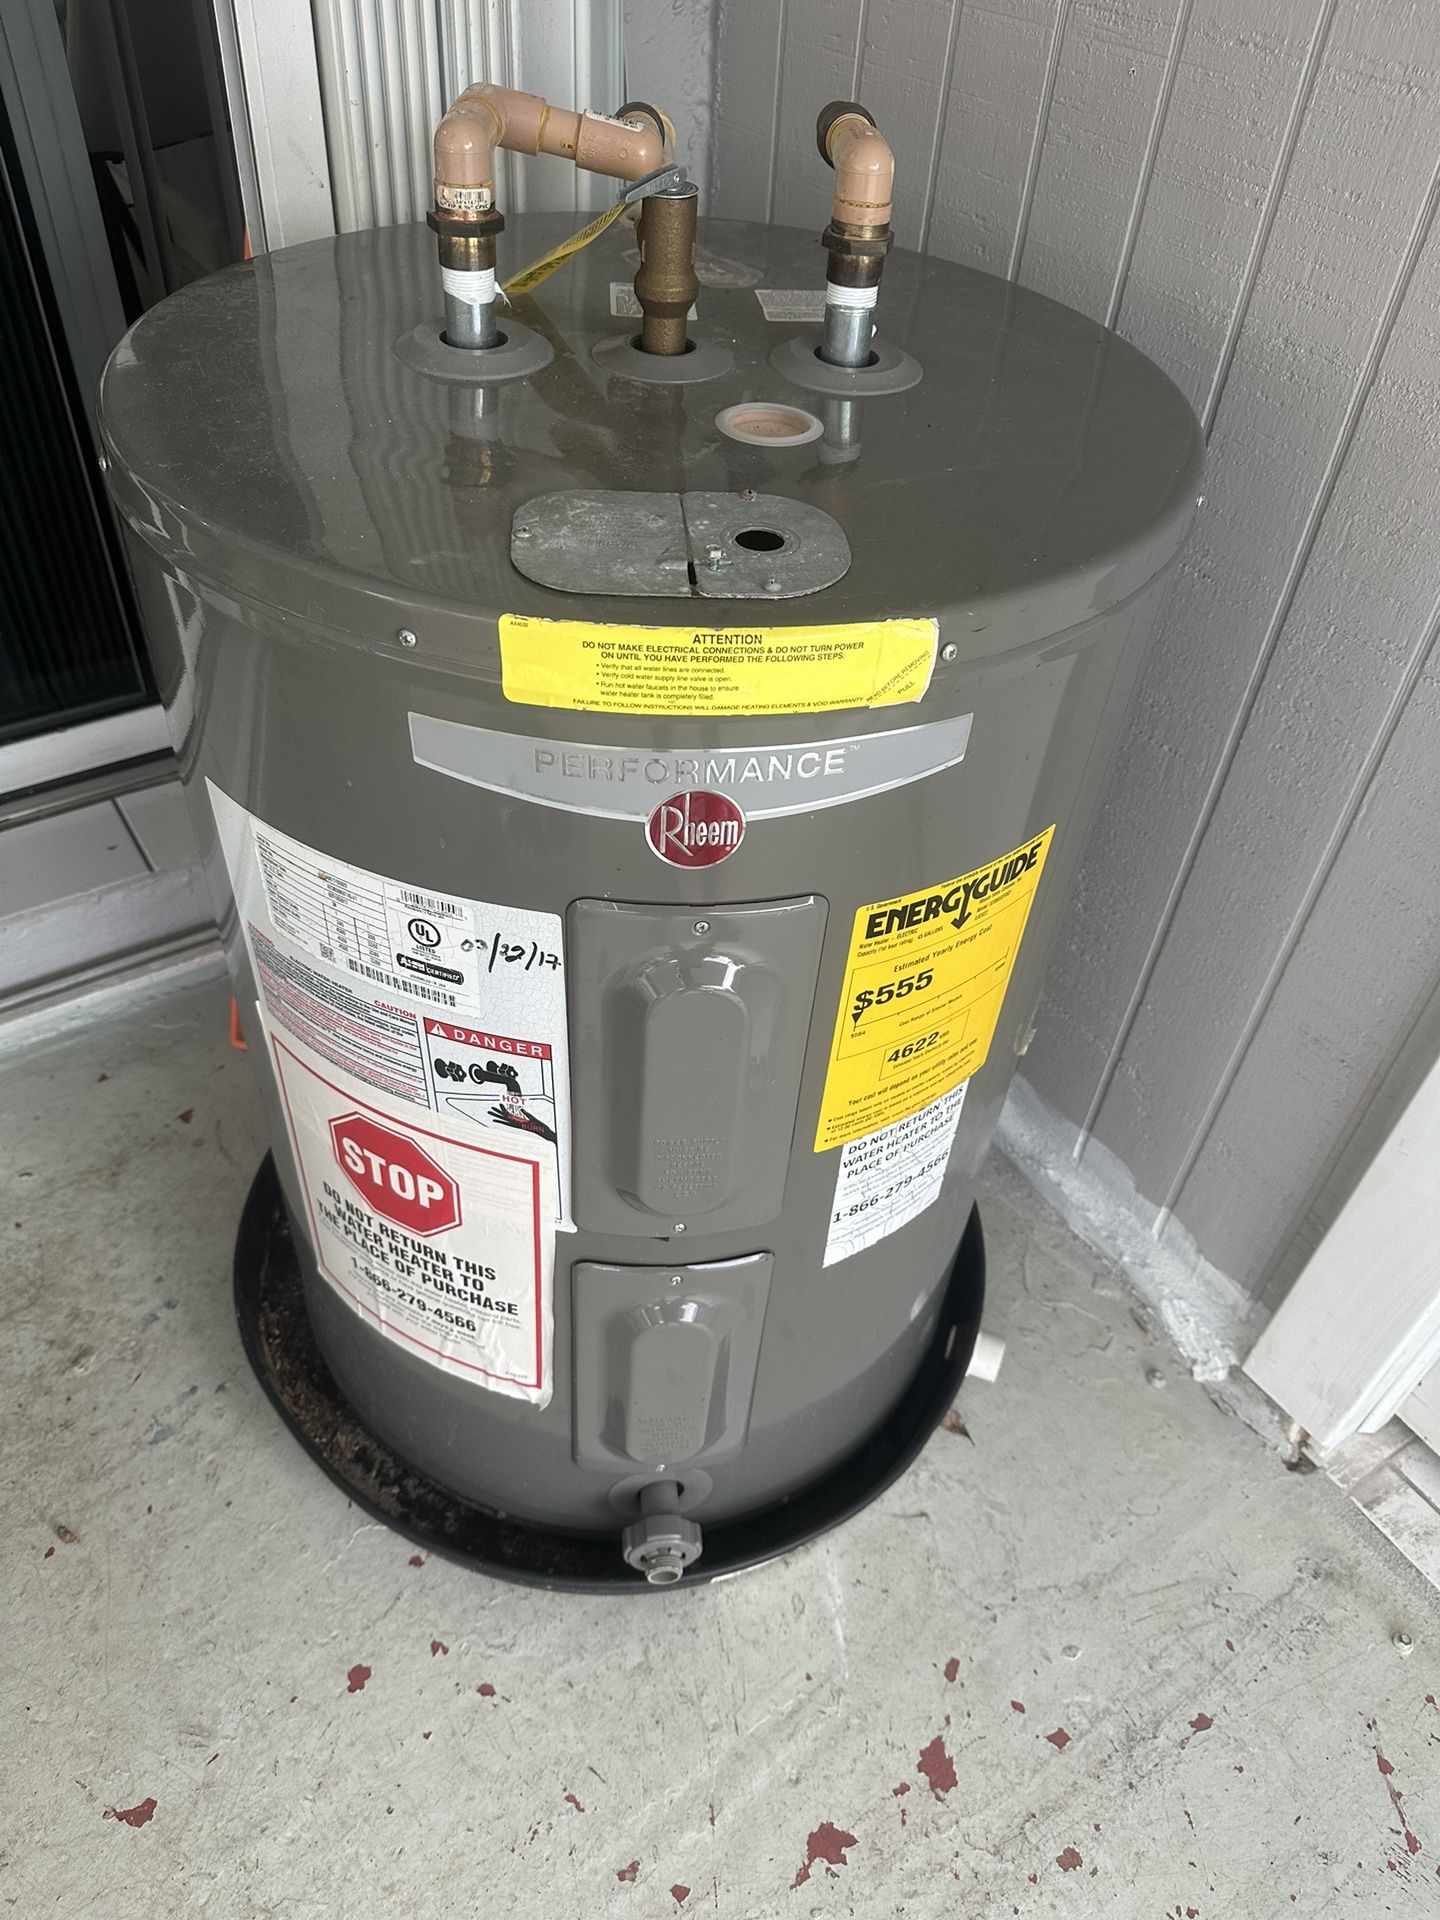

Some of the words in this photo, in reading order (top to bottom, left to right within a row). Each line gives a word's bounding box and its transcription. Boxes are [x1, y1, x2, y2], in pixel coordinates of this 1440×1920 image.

[582, 641, 595, 649] DO
[598, 642, 616, 650] NOT
[618, 643, 644, 652] MAKE
[646, 645, 700, 654] ELECTRICAL
[811, 644, 832, 652] TURN
[834, 642, 864, 650] POWER
[692, 634, 763, 645] ATTENTION
[602, 662, 619, 670] Verify
[644, 654, 663, 662] YOU
[664, 655, 688, 663] HAVE
[690, 655, 744, 663] PERFORMED
[765, 654, 816, 662] FOLLOWING
[817, 652, 846, 661] STEPS:
[880, 672, 902, 693] BEFORE
[901, 650, 930, 675] REMOVING
[602, 671, 619, 679] Verify
[897, 681, 916, 694] PULL
[573, 698, 600, 706] FAILURE
[829, 697, 864, 706] WARRANTY
[663, 692, 697, 701] completely
[660, 793, 739, 856] Rheem
[865, 841, 1042, 939] ENERGYGUIDE
[896, 928, 919, 940] ELECTRIC
[925, 926, 943, 938] GALLONS
[894, 954, 930, 973] Estimated
[932, 944, 954, 958] Yearly
[955, 933, 978, 949] Energy
[979, 924, 993, 936] Cost
[853, 968, 934, 1013] $555
[374, 999, 416, 1019] CAUTION
[453, 1029, 544, 1057] DANGER
[887, 1031, 940, 1063] 4622
[848, 1098, 862, 1106] Your
[863, 1092, 876, 1101] cost
[877, 1085, 888, 1096] will
[889, 1076, 910, 1092] depend
[919, 1067, 931, 1078] your
[931, 1059, 946, 1070] utility
[501, 1094, 527, 1105] HOT
[521, 1123, 545, 1133] BURN
[843, 1145, 884, 1169] WATER
[886, 1122, 927, 1151] HEATER
[930, 1112, 944, 1125] TO
[945, 1096, 963, 1114] THE
[848, 1141, 867, 1155] DO
[870, 1129, 896, 1147] NOT
[898, 1103, 941, 1132] RETURN
[943, 1085, 964, 1105] THIS
[846, 1157, 882, 1179] PLACE
[885, 1149, 900, 1162] OF
[903, 1114, 954, 1152] PURCHASE
[341, 1137, 445, 1209] STOP
[323, 1180, 341, 1203] DO
[345, 1198, 374, 1227] NOT
[379, 1222, 447, 1265] RETURN
[453, 1256, 497, 1281] THIS
[318, 1199, 341, 1232] THE
[345, 1226, 391, 1266] PLACE
[395, 1260, 415, 1278] OF
[422, 1271, 519, 1316] PURCHASE
[334, 1204, 385, 1248] WATER
[389, 1242, 454, 1282] HEATER
[460, 1273, 485, 1293] TO
[351, 1257, 477, 1333] 1-866-279-4566
